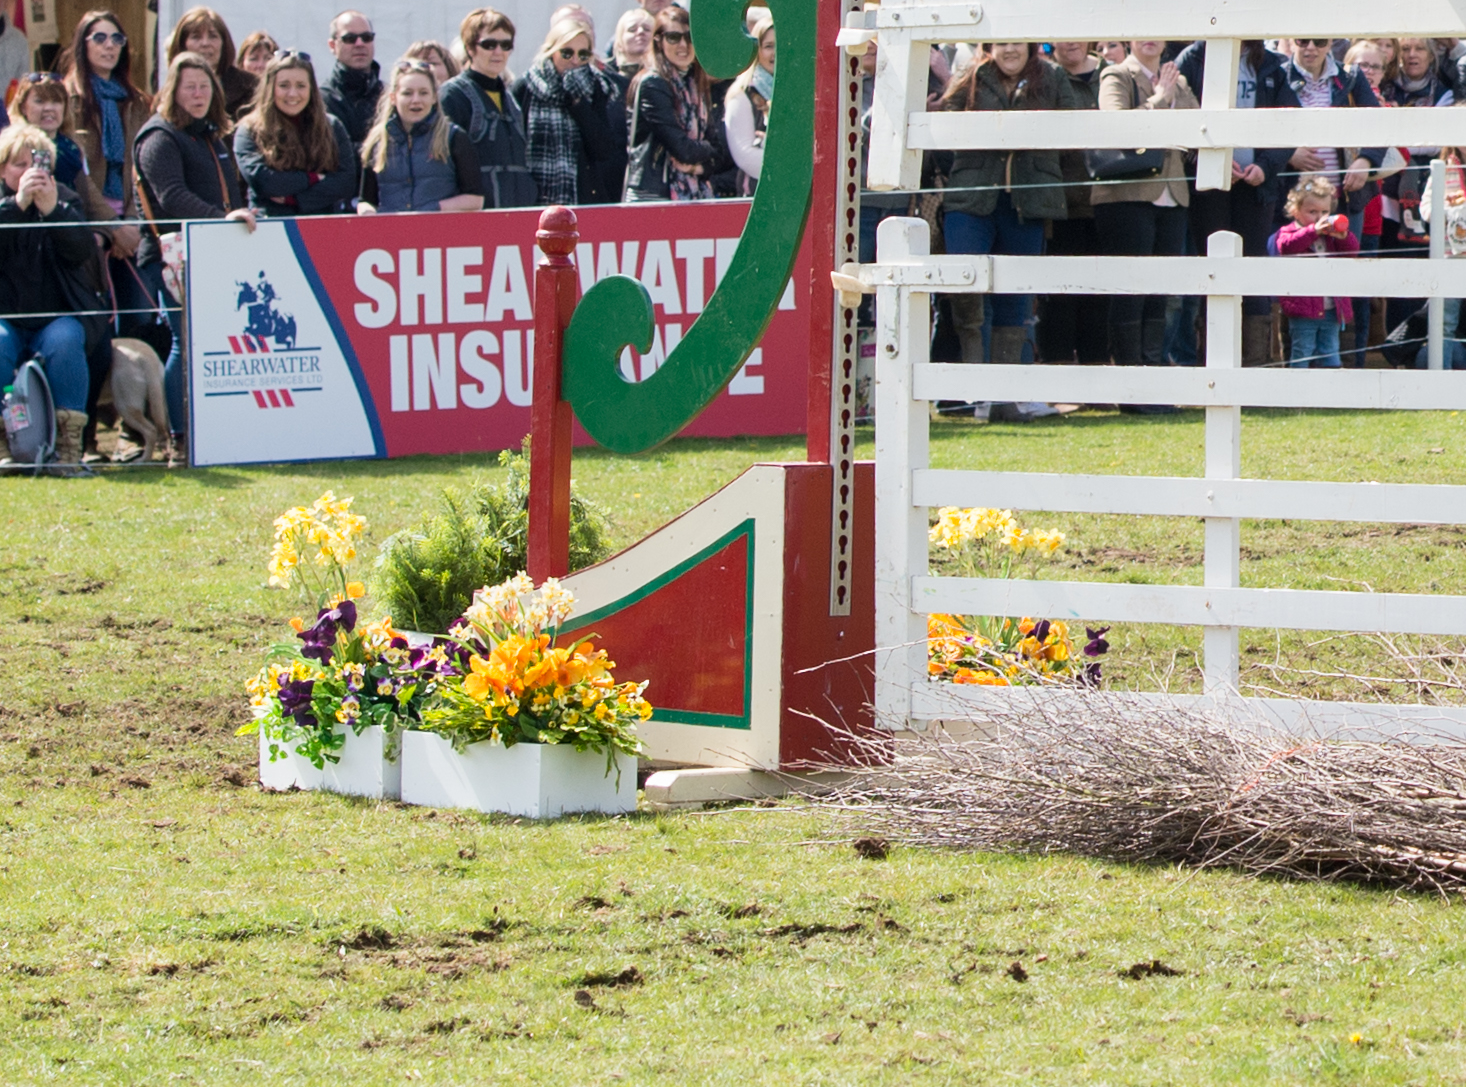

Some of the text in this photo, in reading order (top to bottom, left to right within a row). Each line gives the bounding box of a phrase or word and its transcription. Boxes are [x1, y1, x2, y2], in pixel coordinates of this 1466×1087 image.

[203, 355, 321, 377] SHEARWATER
[203, 374, 323, 389] INSURANCE SERVICES LTD
